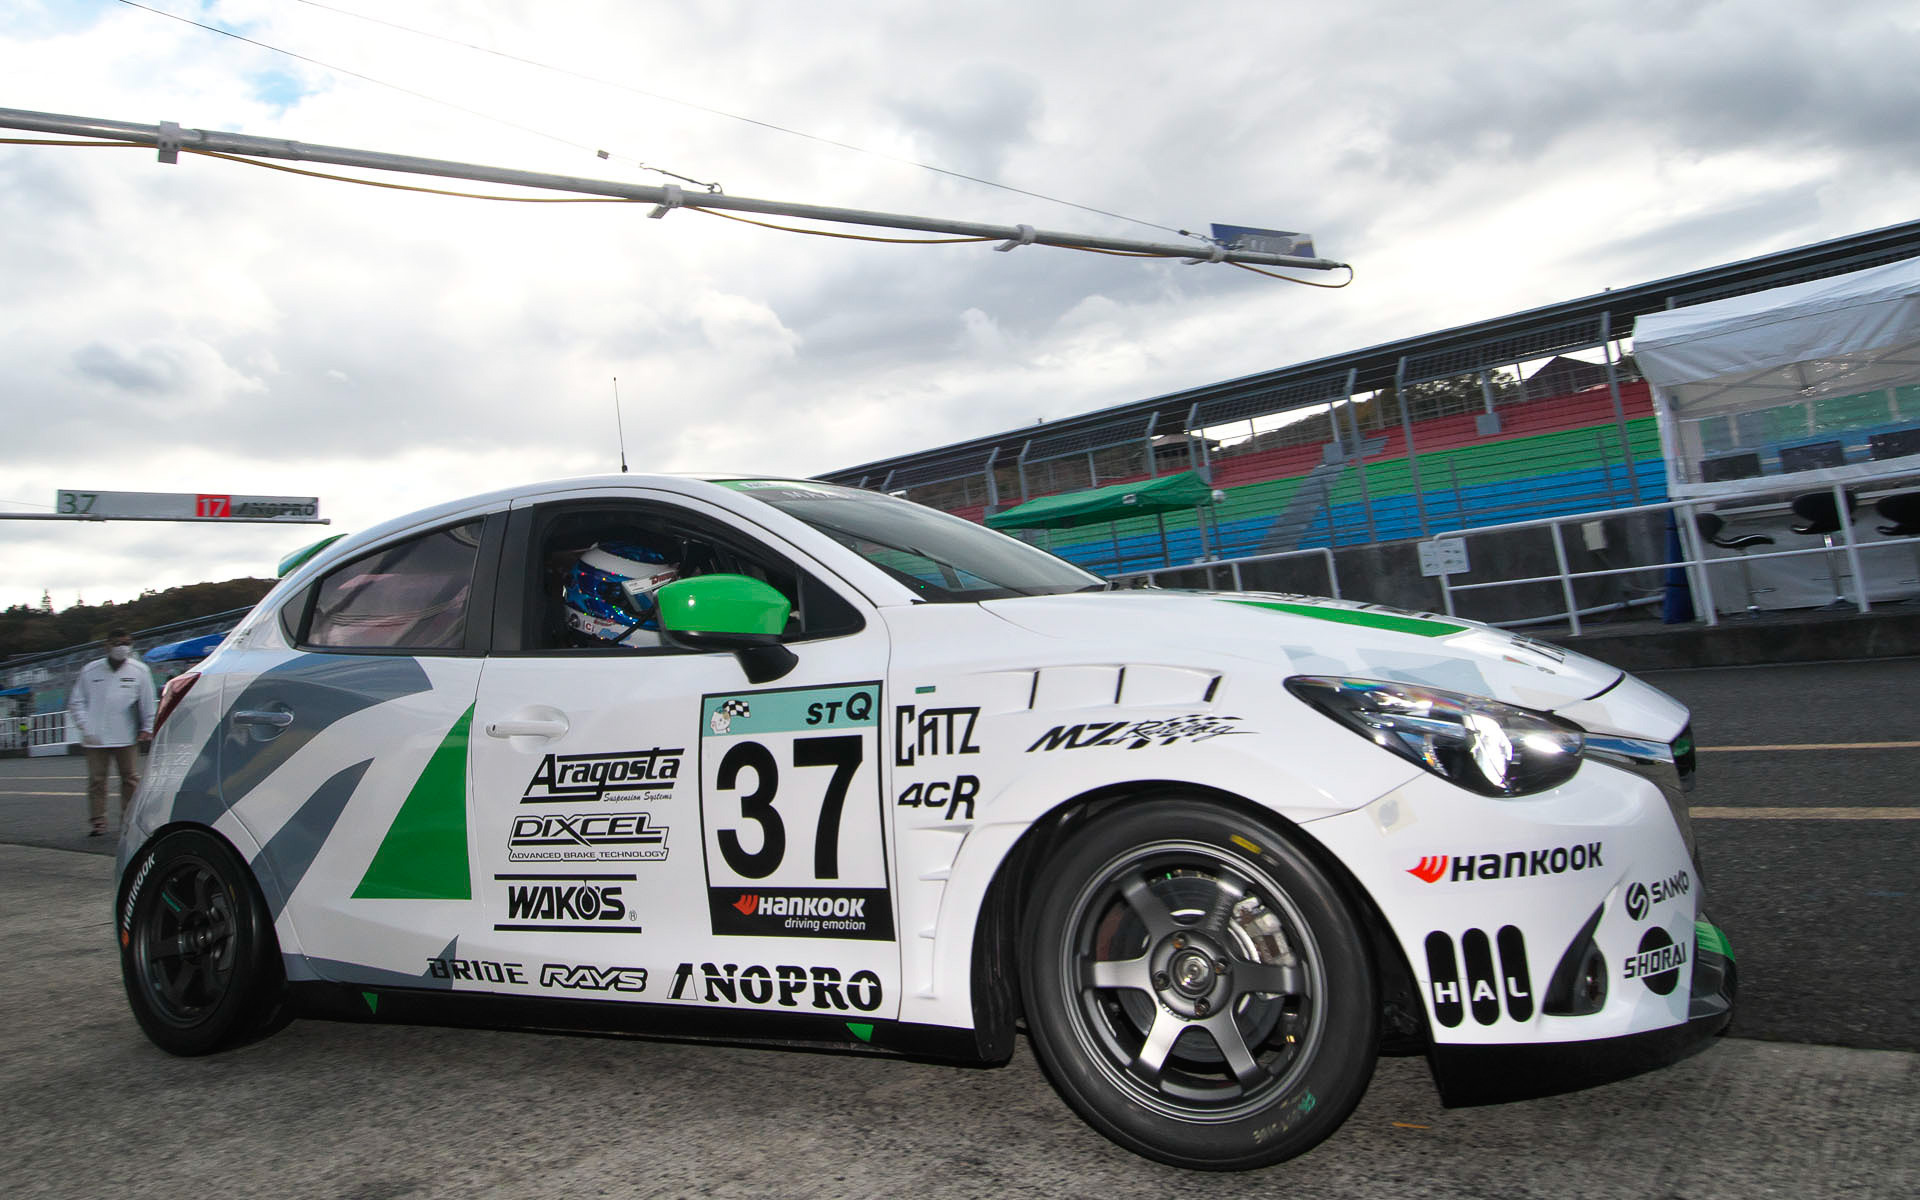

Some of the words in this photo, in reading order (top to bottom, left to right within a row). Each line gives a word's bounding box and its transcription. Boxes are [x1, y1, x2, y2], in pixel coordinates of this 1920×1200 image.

[61, 493, 97, 515] 37
[200, 497, 227, 517] 17
[896, 705, 981, 767] CATZ
[520, 747, 685, 804] Aragosta
[603, 790, 641, 804] Suspension
[643, 790, 673, 802] Systems
[716, 735, 863, 880] 37
[898, 774, 981, 821] 4CR
[513, 816, 662, 847] DIXCEL
[511, 852, 562, 860] ADVANCED
[563, 851, 596, 859] BRAKE
[599, 849, 667, 859] TECHNOLOGY
[785, 917, 821, 932] driving
[823, 918, 866, 931] emotion
[427, 958, 529, 985] BRIDE
[1623, 942, 1688, 979] SHORAI
[541, 965, 647, 991] RAYS
[1433, 976, 1529, 1004] HAL
